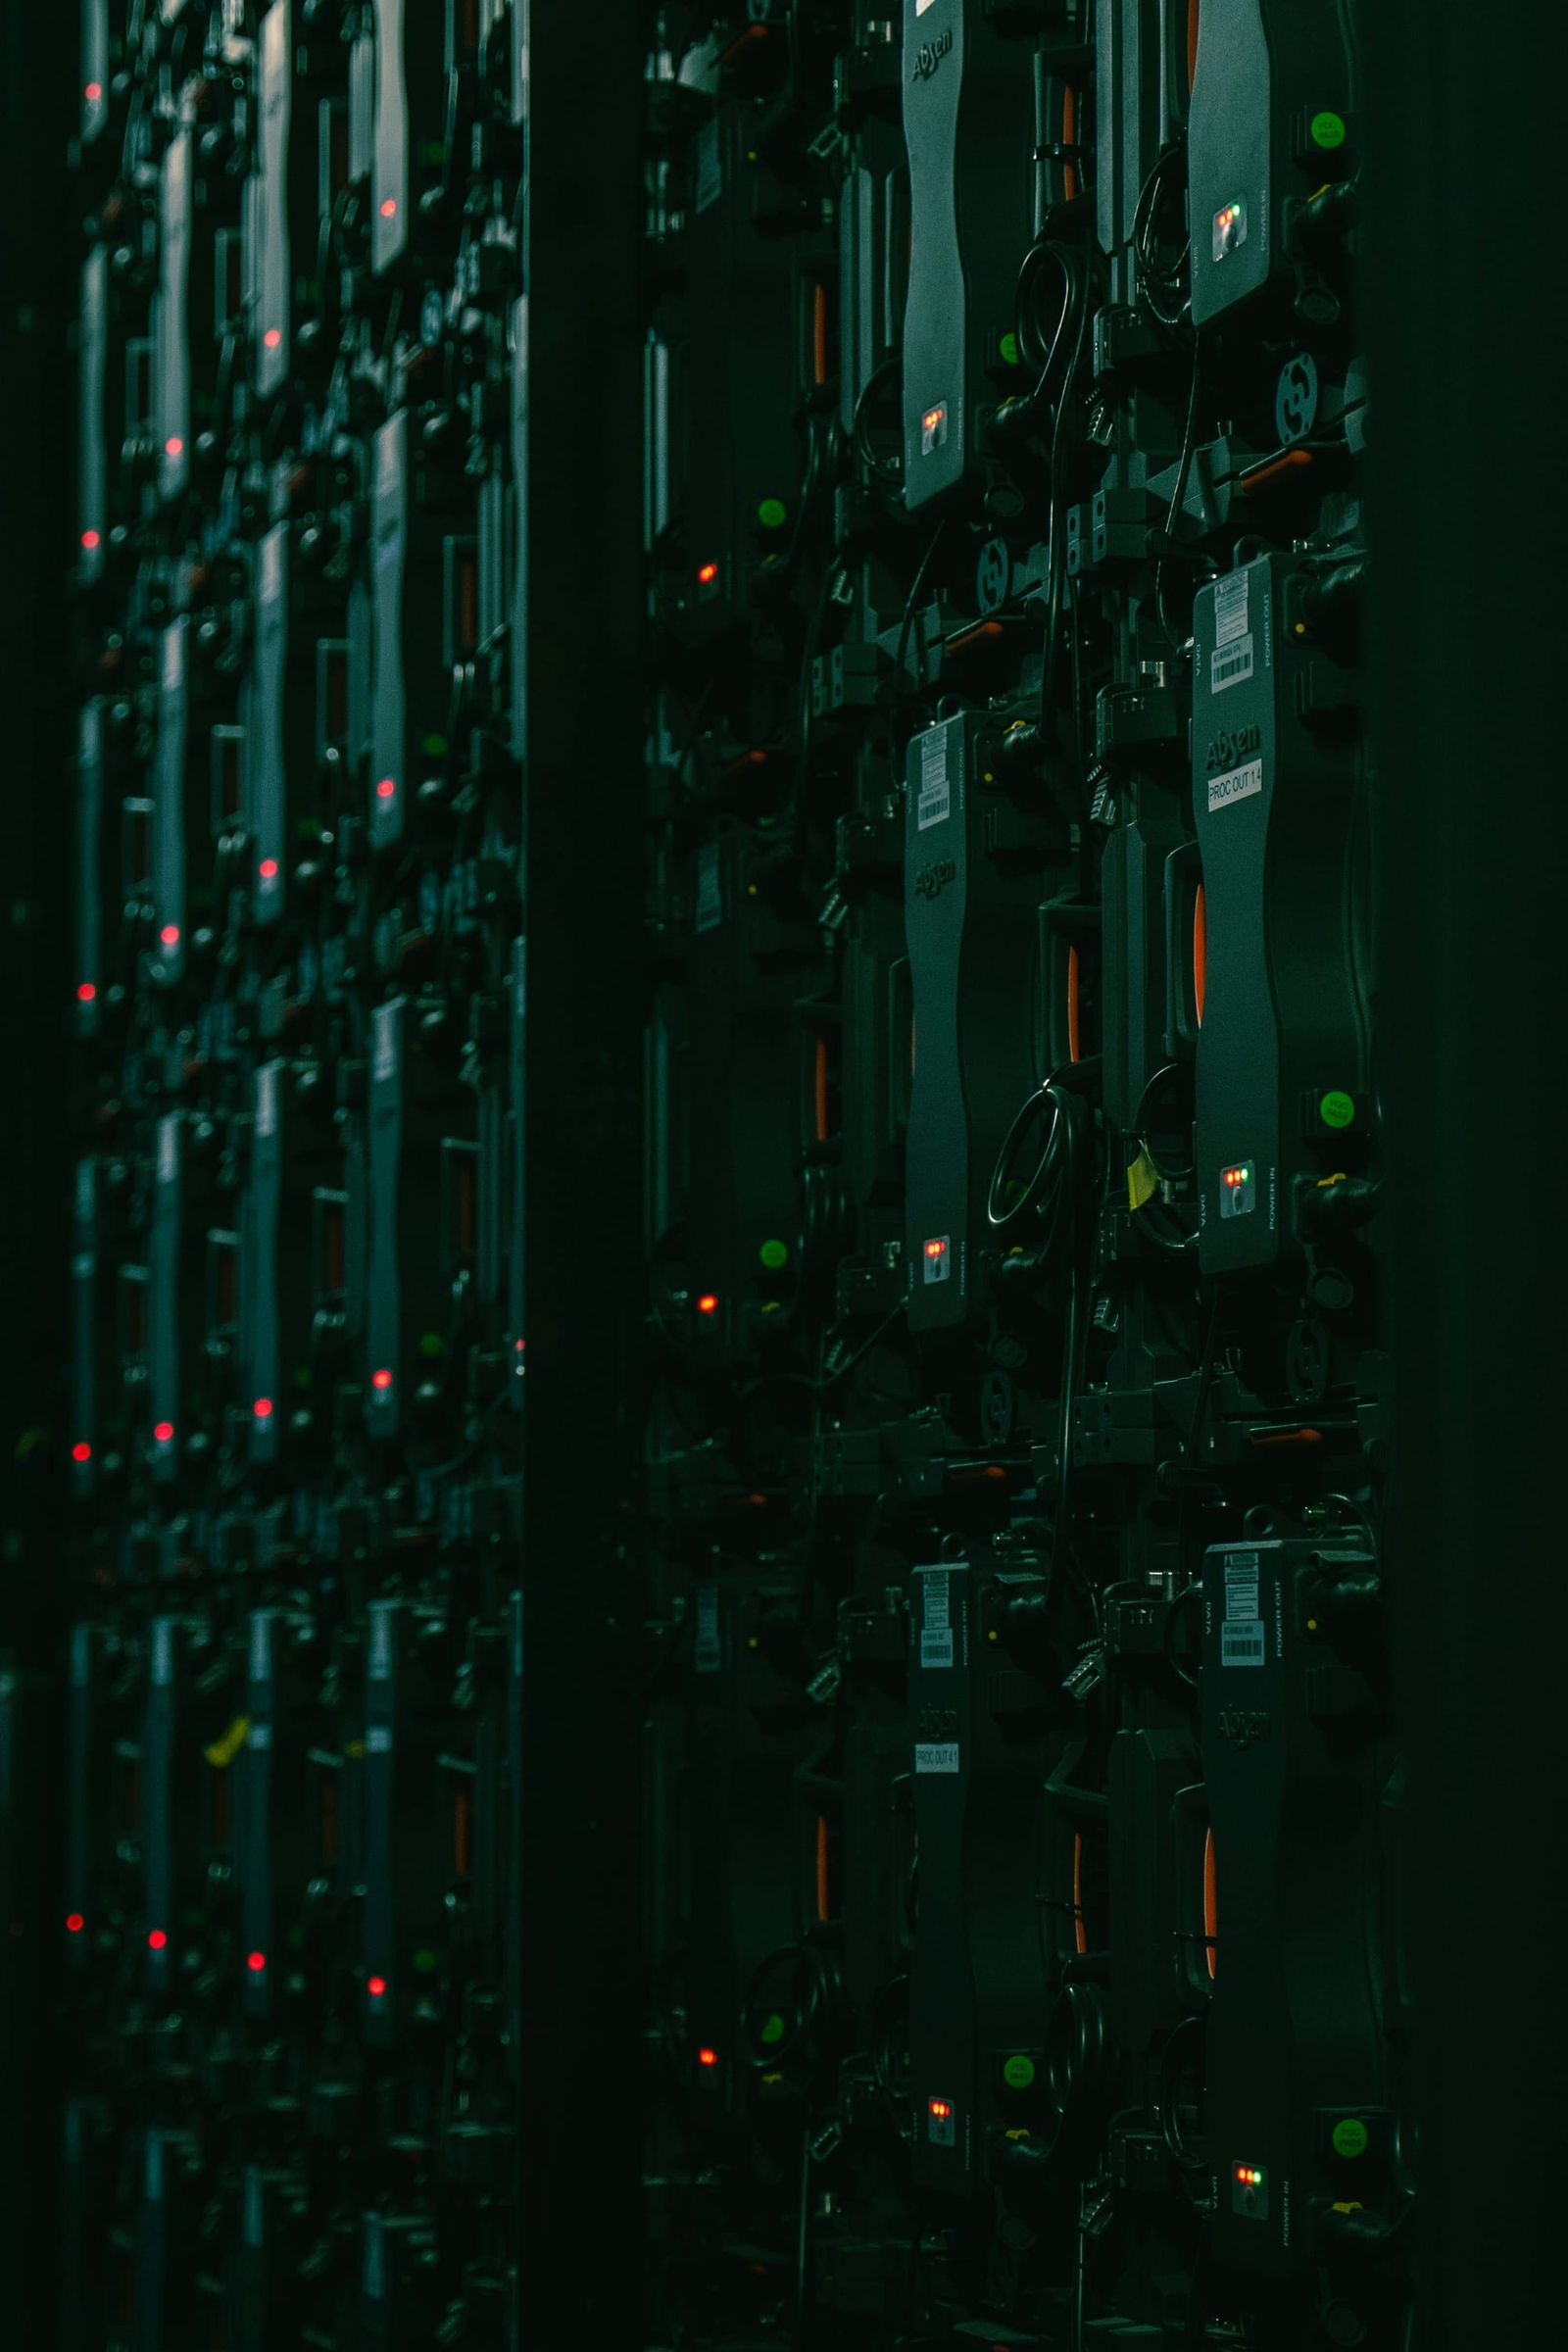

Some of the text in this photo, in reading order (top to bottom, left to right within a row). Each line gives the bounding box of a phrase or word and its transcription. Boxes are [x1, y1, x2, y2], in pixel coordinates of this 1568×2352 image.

[912, 28, 953, 82] Absen
[1205, 723, 1261, 772] Absen
[1209, 779, 1232, 803] PROC
[1232, 771, 1249, 792] OUT
[1269, 1167, 1275, 1180] IN
[935, 1749, 948, 1765] OUT
